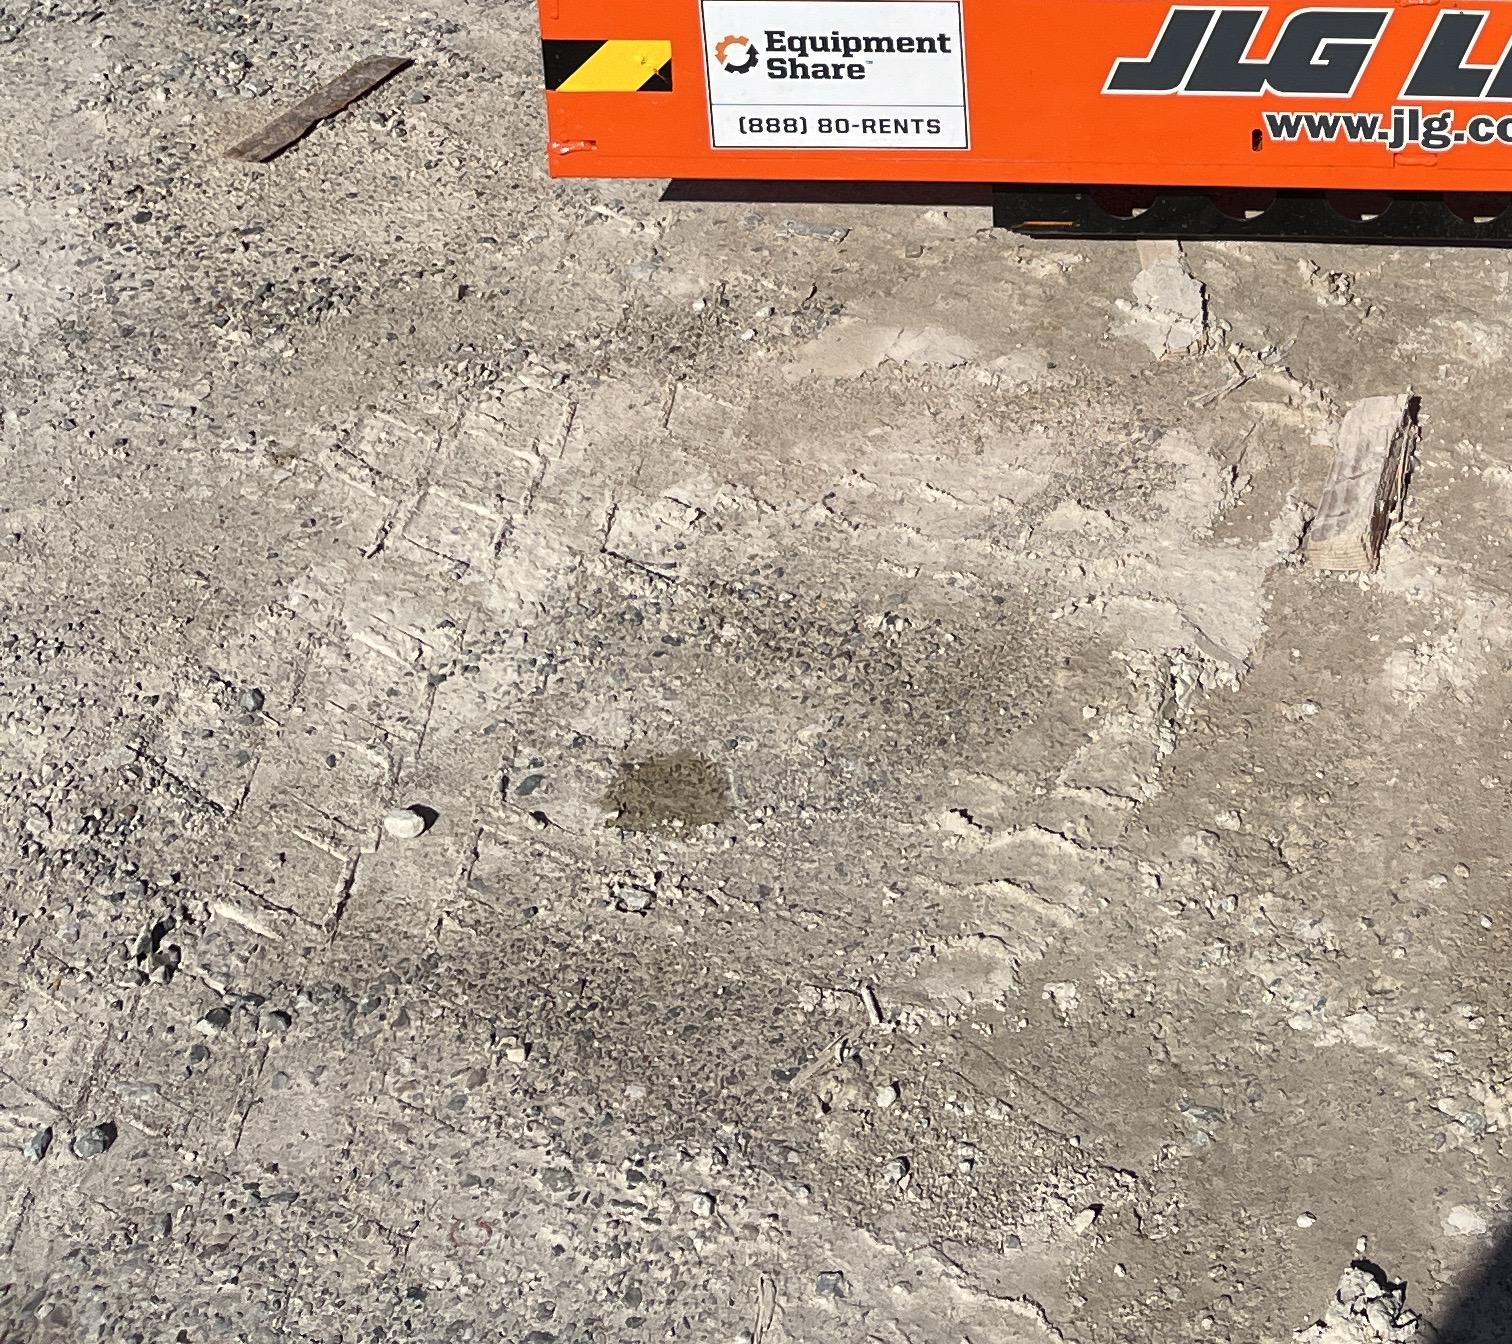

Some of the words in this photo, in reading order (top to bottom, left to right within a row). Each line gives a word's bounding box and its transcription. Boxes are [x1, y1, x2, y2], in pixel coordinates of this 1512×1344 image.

[764, 28, 952, 60] Equipment
[1101, 5, 1395, 98] JLG
[765, 56, 866, 81] Share
[738, 116, 806, 136] (888)
[817, 116, 942, 136] 80-RENTS
